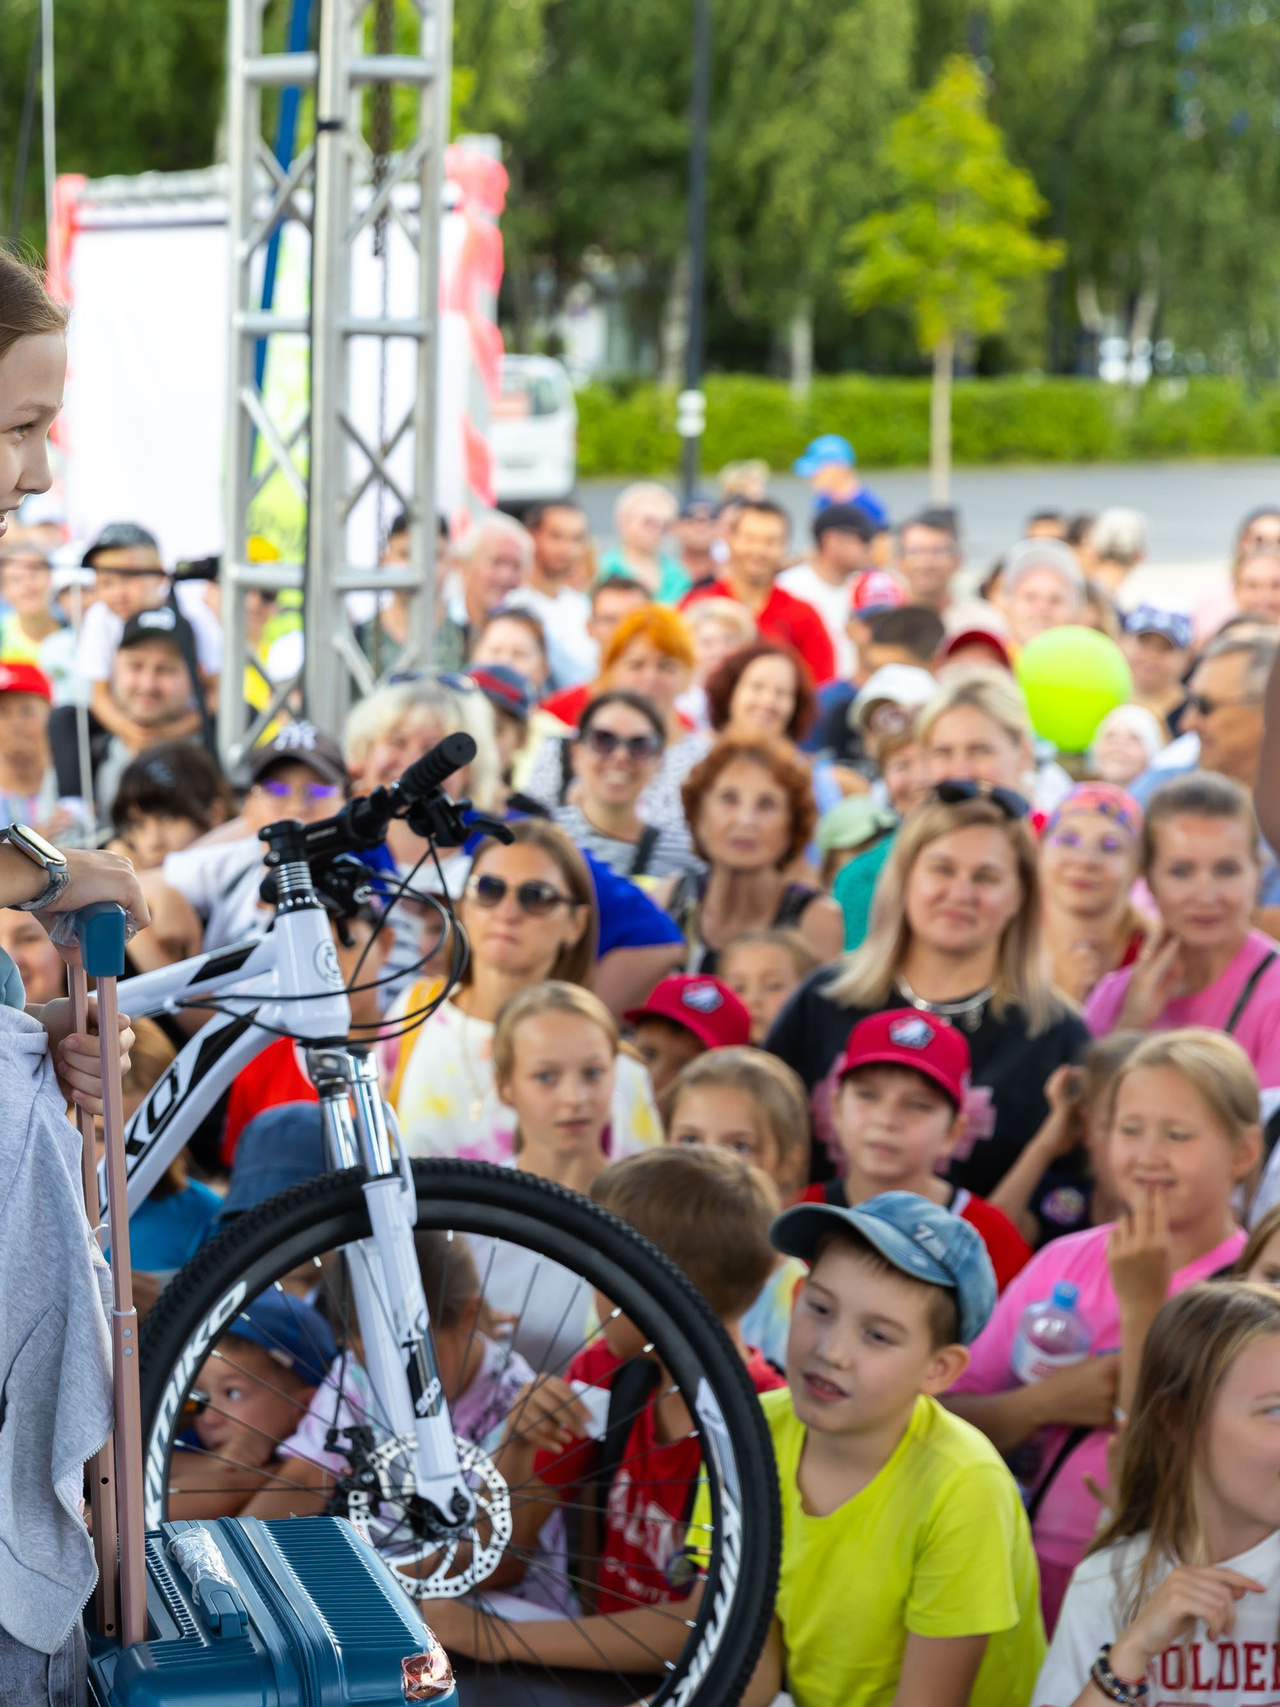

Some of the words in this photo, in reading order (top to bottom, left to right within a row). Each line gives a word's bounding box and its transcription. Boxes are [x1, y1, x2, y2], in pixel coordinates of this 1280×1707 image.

[145, 1281, 248, 1531] KIMIKO
[663, 1489, 743, 1707] KIMIK
[1148, 1642, 1280, 1691] OLDE
